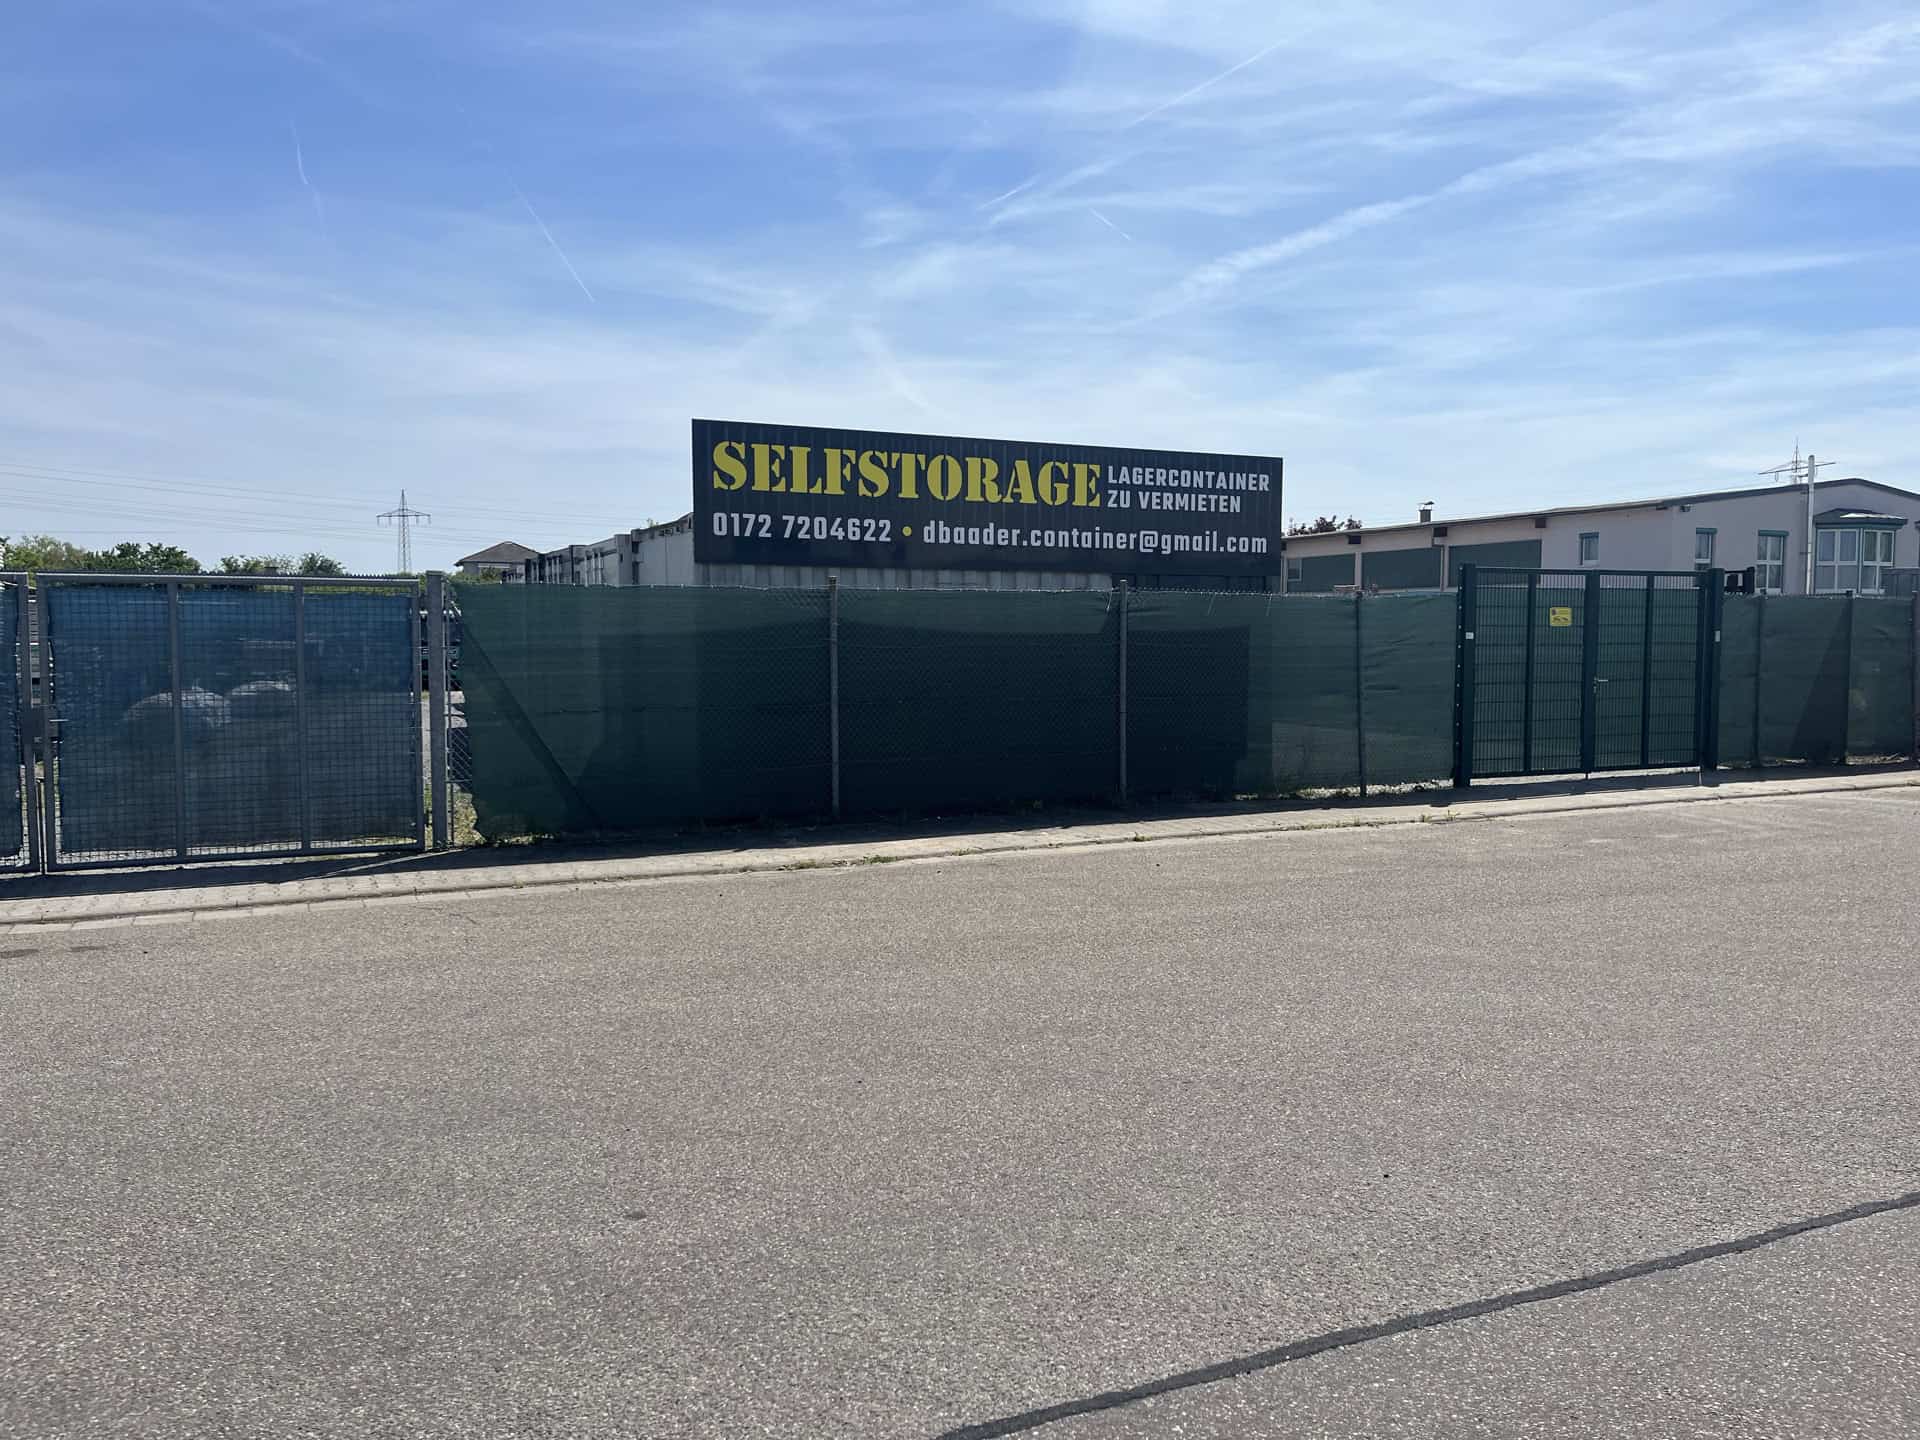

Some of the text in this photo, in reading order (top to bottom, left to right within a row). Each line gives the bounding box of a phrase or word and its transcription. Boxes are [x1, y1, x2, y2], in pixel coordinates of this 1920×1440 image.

[712, 440, 1101, 507] SELFSTORAGE
[1107, 465, 1270, 491] LAGERCONTAINER
[1107, 490, 1241, 513] ZU VERMIETEN
[712, 511, 1268, 555] 0172 7204622 dbaader.container@gmail.com
